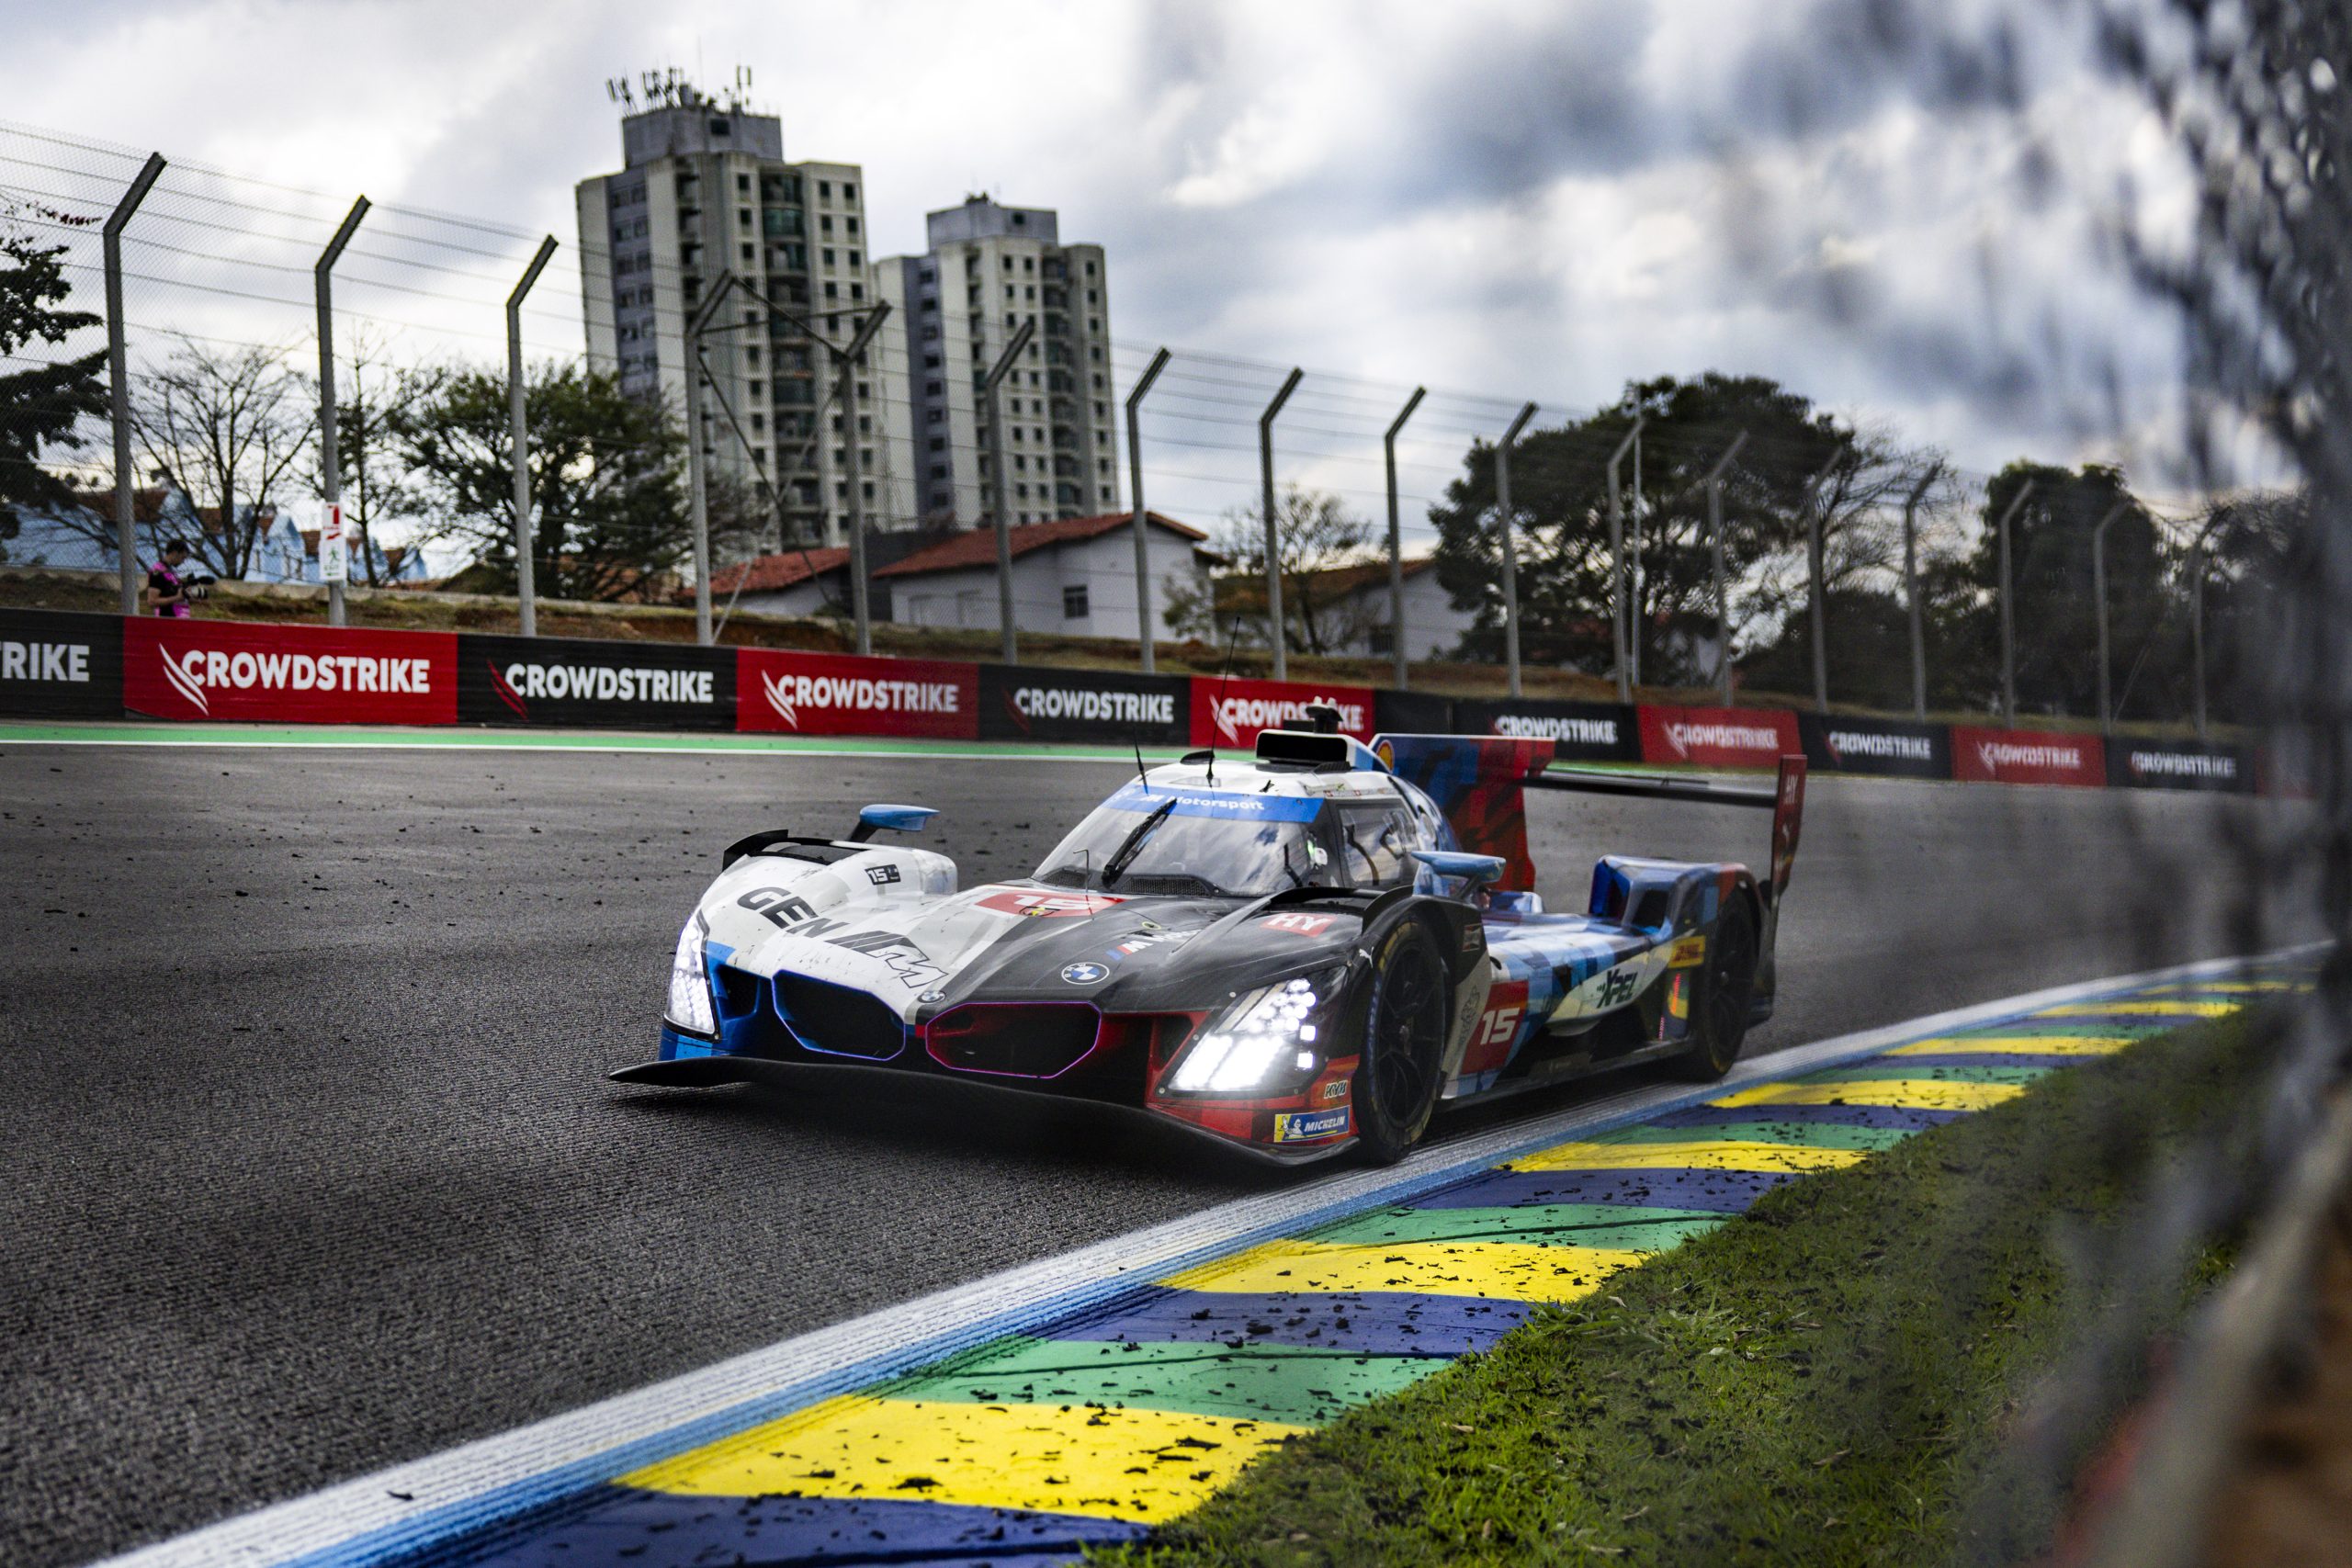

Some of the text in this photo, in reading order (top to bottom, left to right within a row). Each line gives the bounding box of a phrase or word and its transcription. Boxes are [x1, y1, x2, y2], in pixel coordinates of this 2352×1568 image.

[0, 641, 90, 682] RIKE
[183, 649, 430, 694] CROWDSTRIKE
[505, 663, 714, 704] CROWDSTRIKE
[777, 675, 959, 713] CROWDSTRIKE
[1014, 688, 1175, 724] CROWDSTRIKE
[1222, 697, 1364, 732] CROWDSKE
[1496, 716, 1618, 744] CROWDSTRIKE
[1672, 723, 1779, 750] CROWDSTRIKE
[1829, 731, 1930, 760] CROWDSTRIKE
[1984, 742, 2080, 768] CROWDSTRIKE
[866, 868, 888, 882] 15
[737, 886, 849, 938] GEN
[1014, 895, 1100, 910] 15
[1268, 914, 1331, 931] HY
[1597, 969, 1638, 1009] XPEL
[1480, 1007, 1521, 1045] 15
[1324, 1080, 1348, 1099] KYB
[1305, 1116, 1346, 1132] MICHELIN
